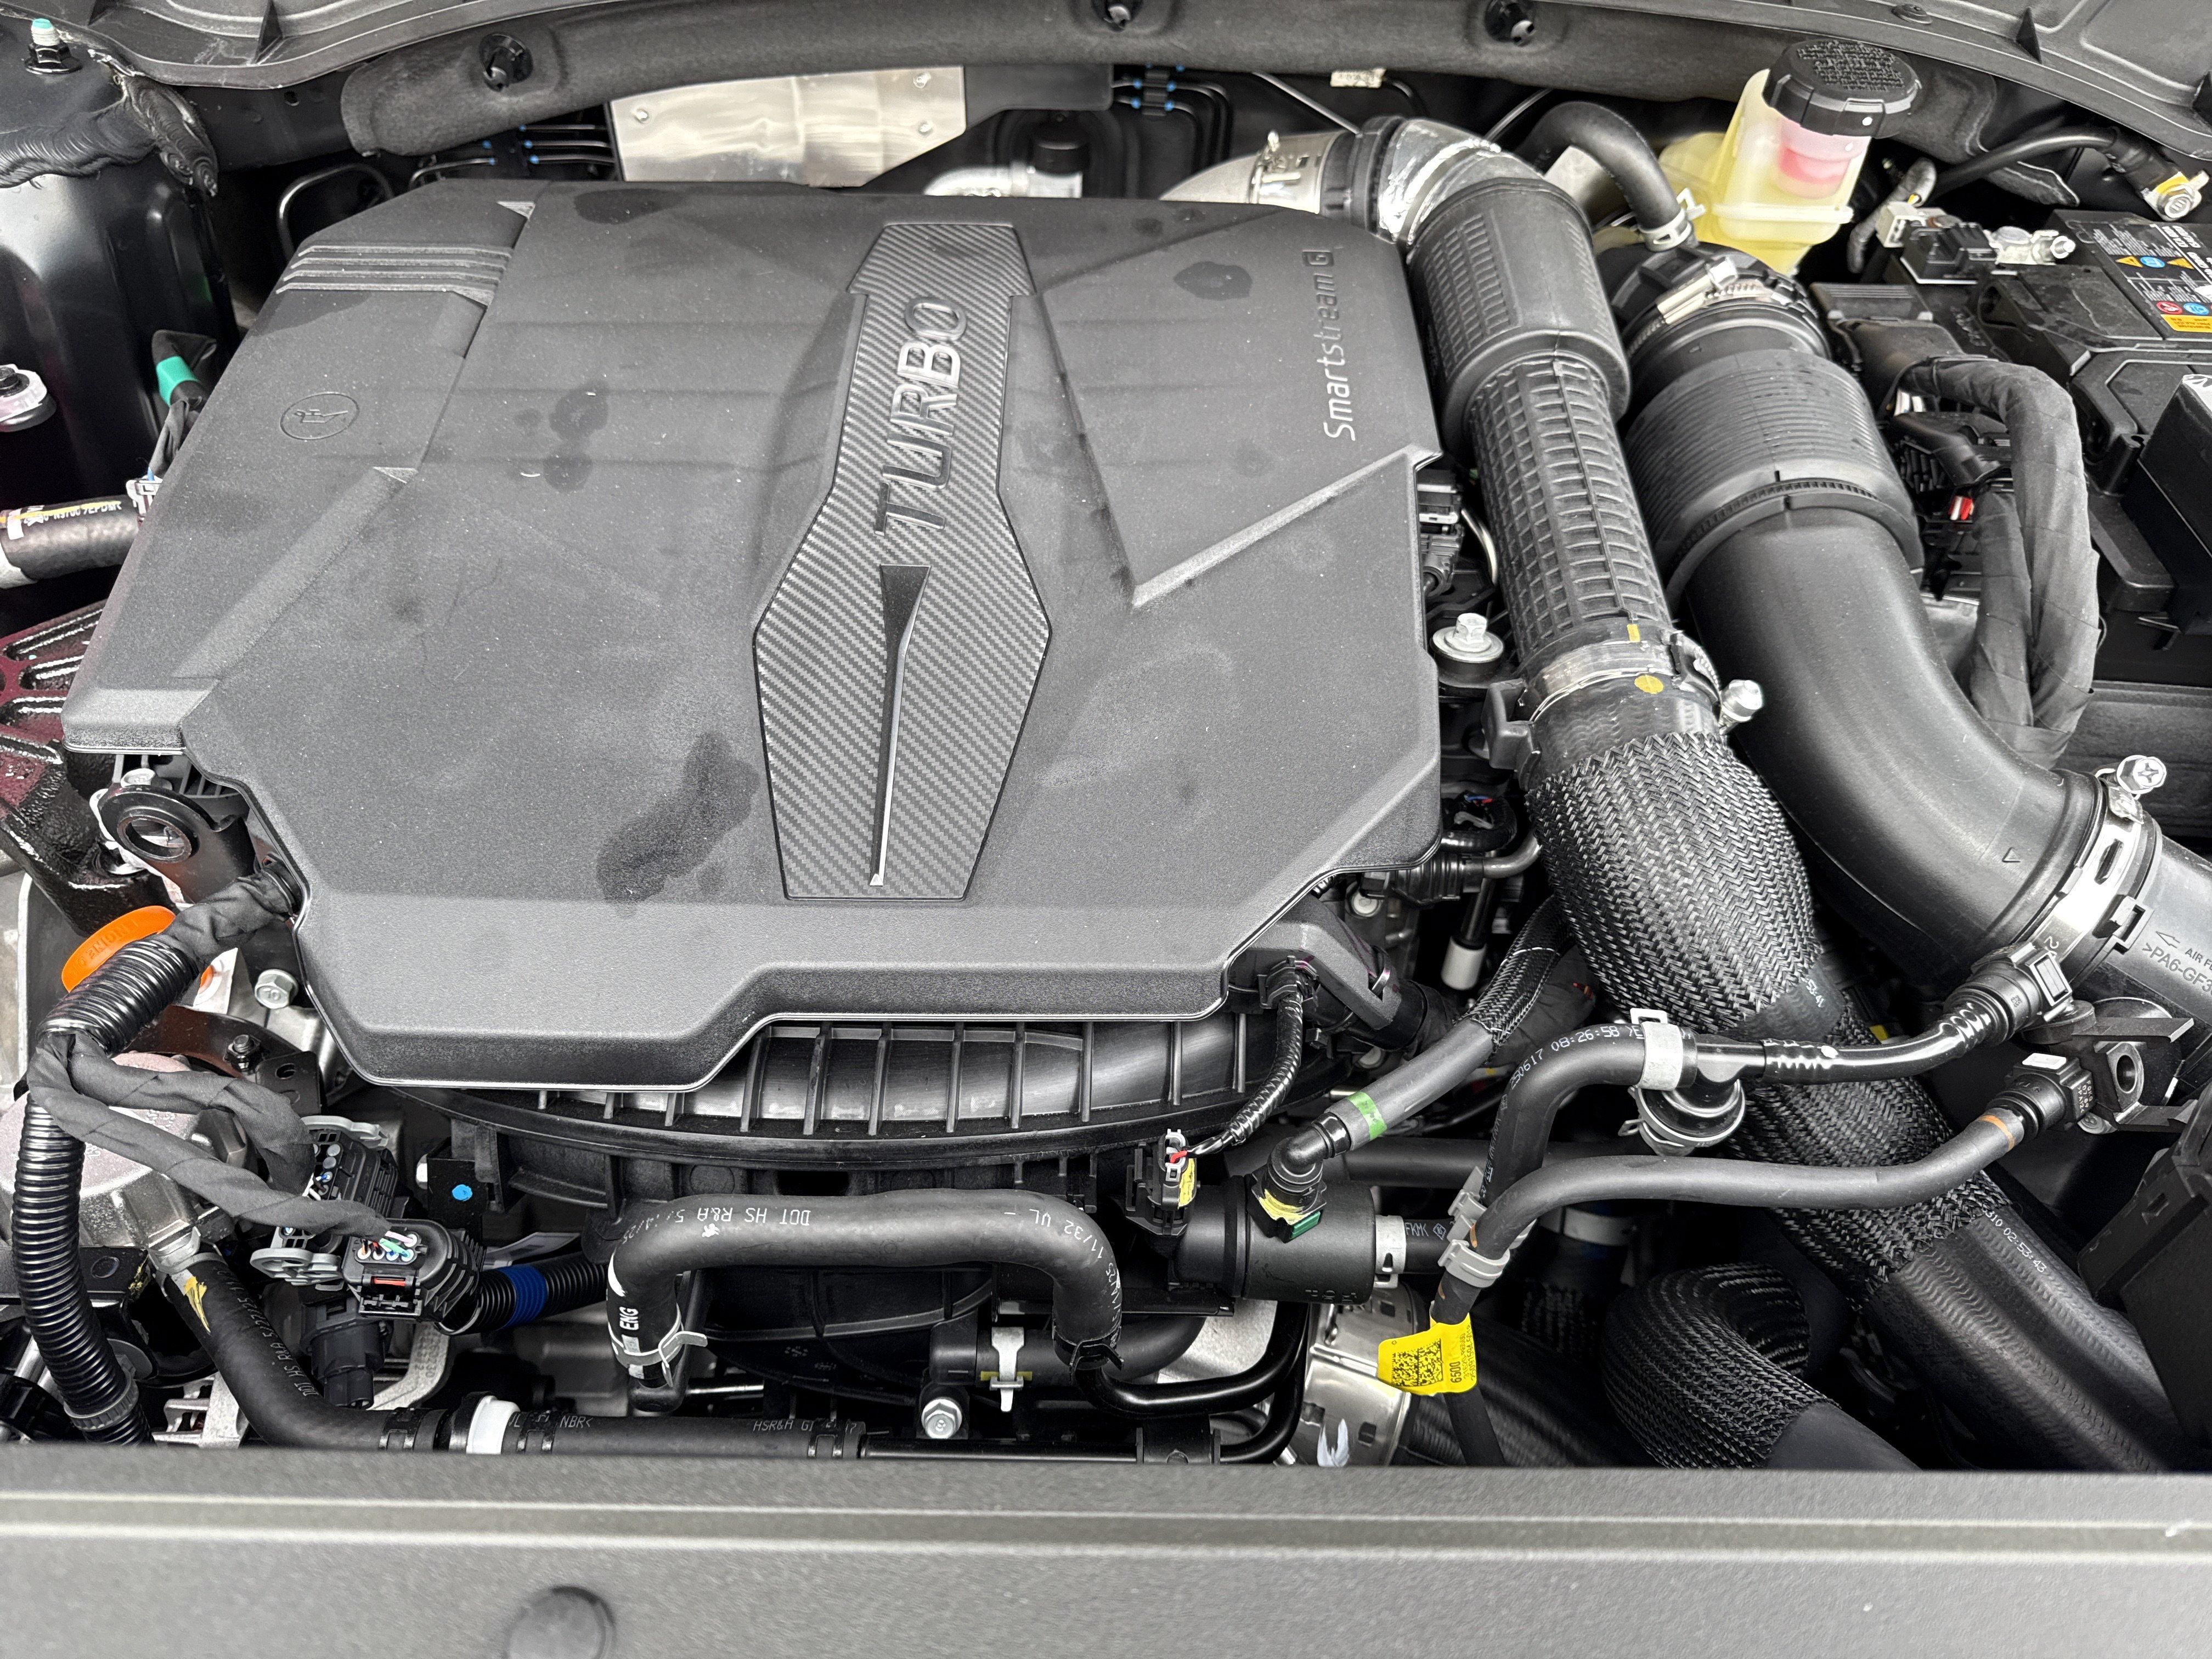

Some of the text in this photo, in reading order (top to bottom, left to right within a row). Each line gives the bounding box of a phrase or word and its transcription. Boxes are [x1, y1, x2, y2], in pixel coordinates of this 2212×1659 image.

[1302, 250, 1356, 441] Smartstream G
[875, 296, 967, 537] TURBO
[2185, 947, 2204, 964] AIR
[1510, 1047, 1544, 1090] 250617
[1550, 1025, 1621, 1052] 08:26:58
[696, 1206, 733, 1223] R&A
[744, 1207, 768, 1224] HS
[779, 1208, 812, 1226] DOT
[1029, 1208, 1052, 1227] UL
[1063, 1219, 1104, 1259] 11/32
[2003, 1227, 2047, 1273] 02:53:43
[618, 1306, 640, 1331] ENG
[283, 1364, 306, 1378] HS
[1449, 1361, 1463, 1384] 6500
